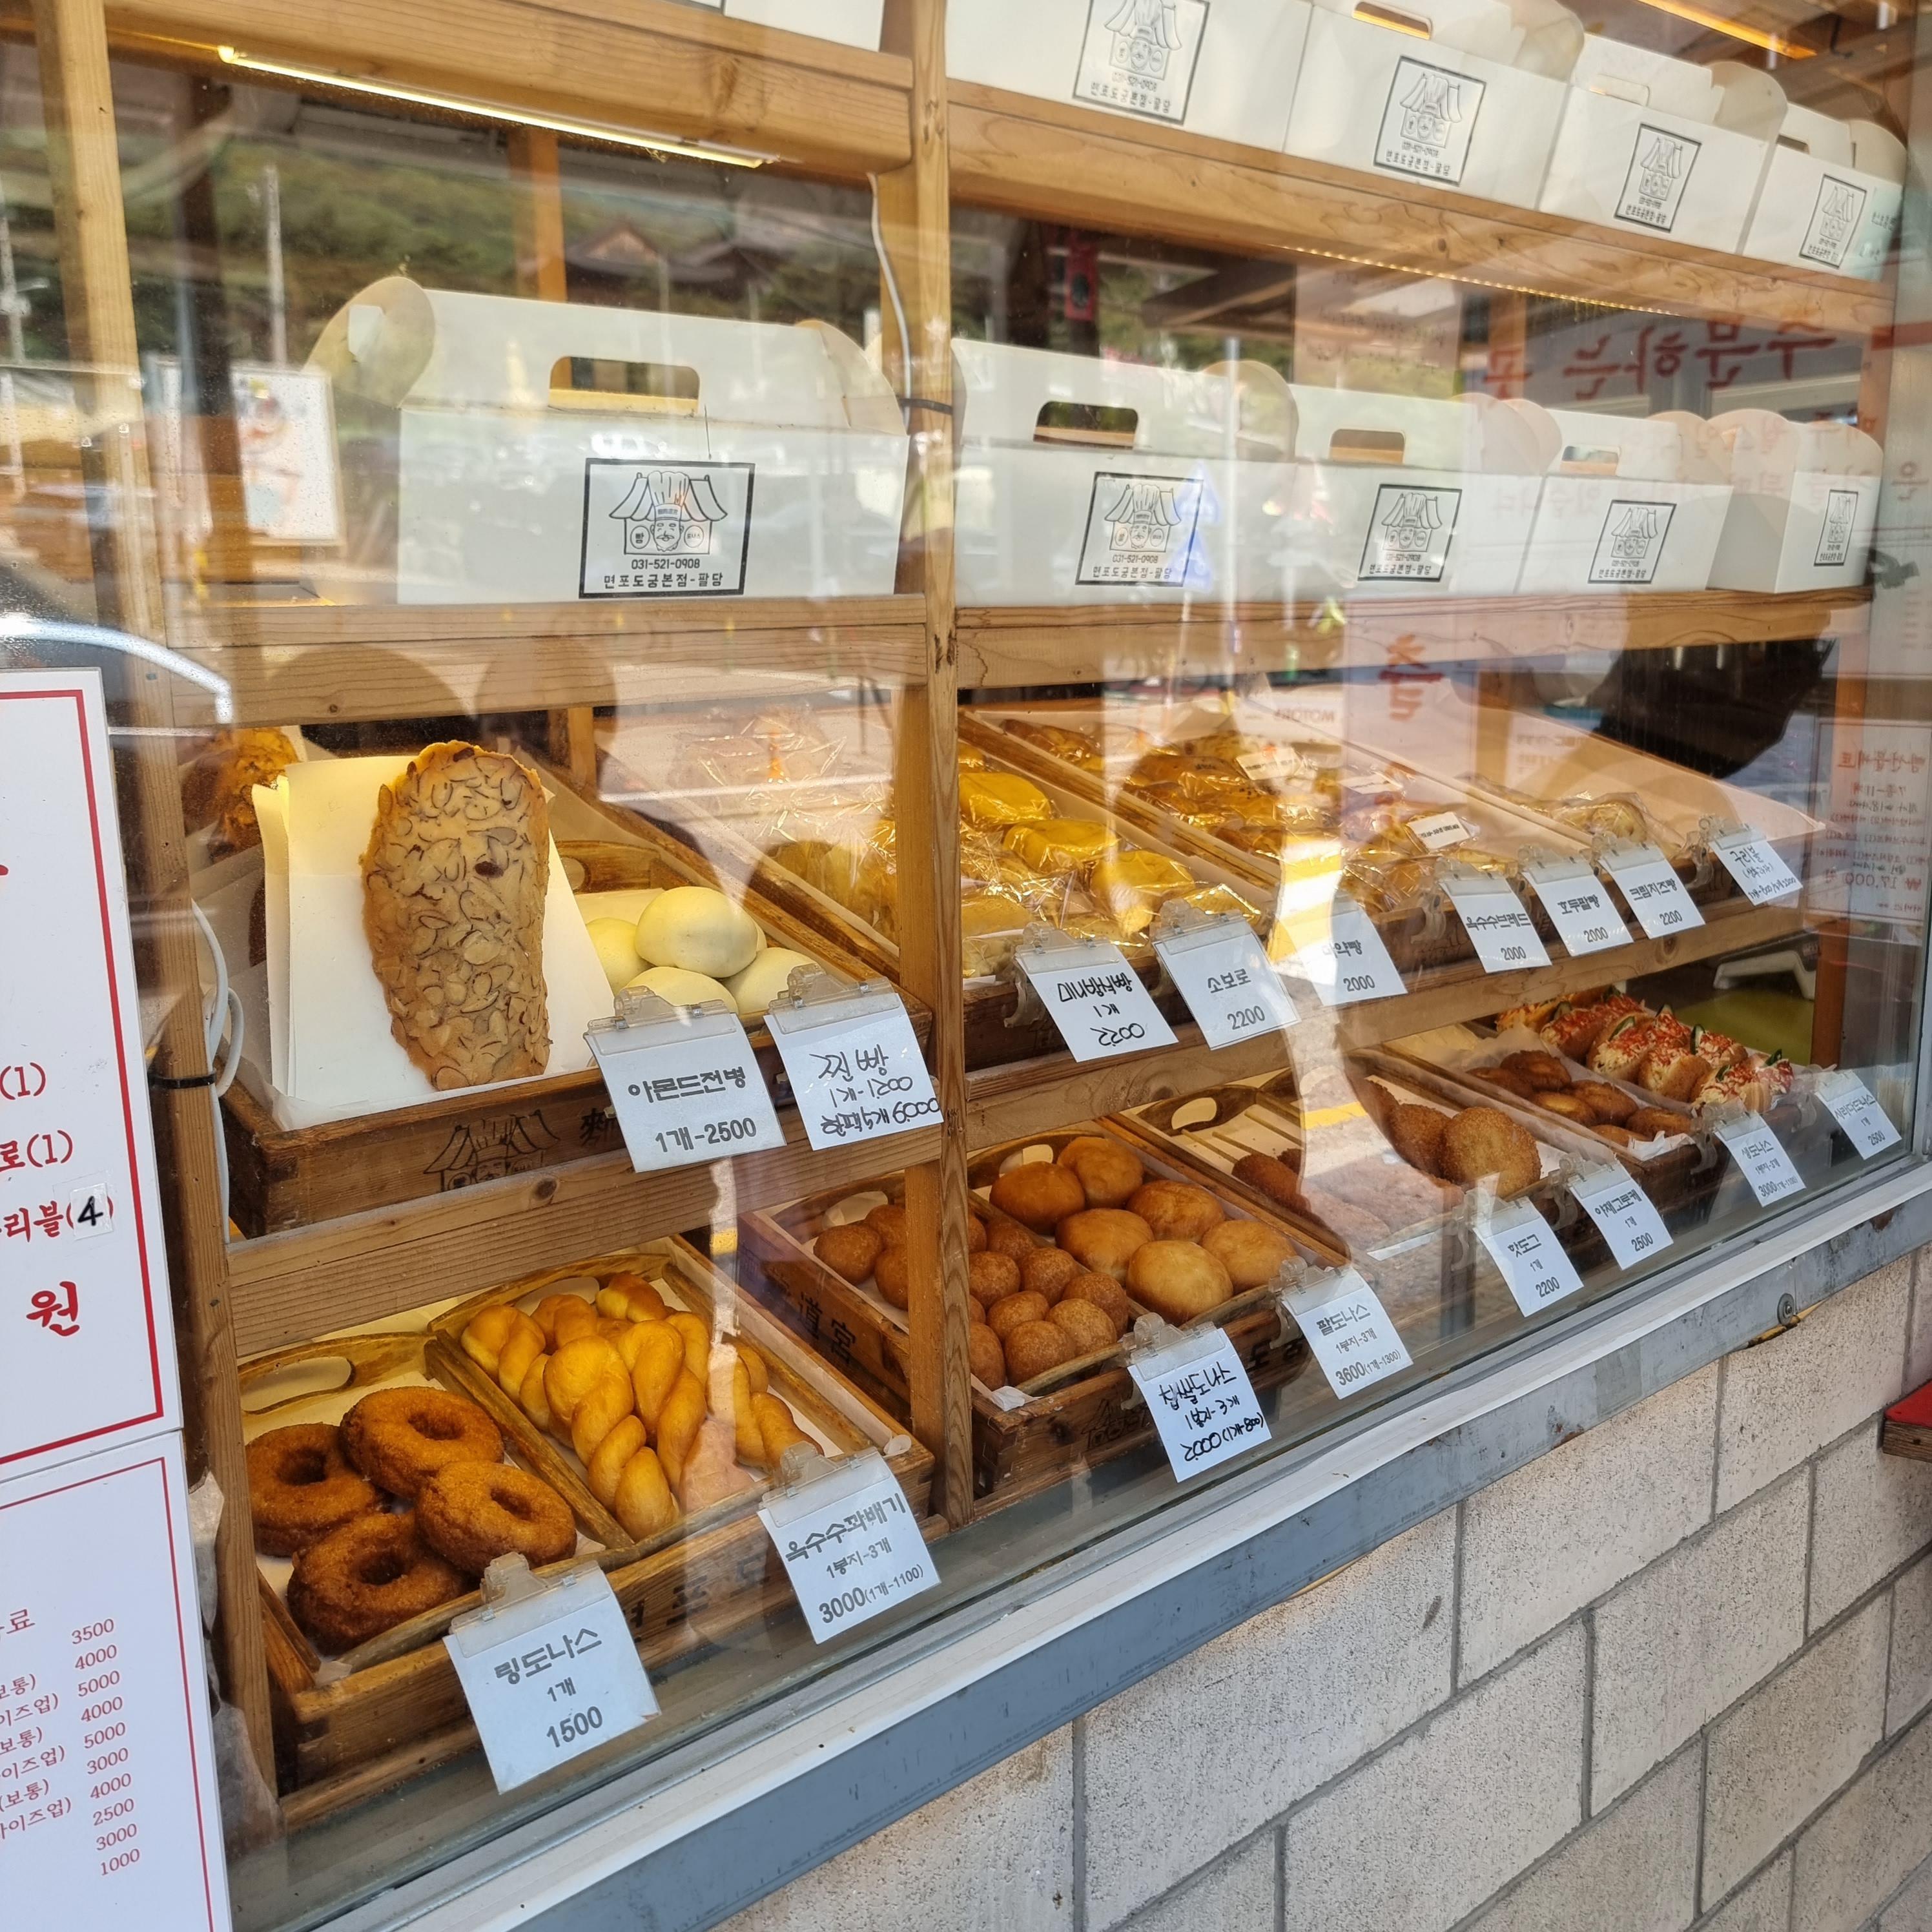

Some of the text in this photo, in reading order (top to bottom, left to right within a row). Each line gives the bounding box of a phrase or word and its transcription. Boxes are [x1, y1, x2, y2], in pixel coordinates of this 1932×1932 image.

[631, 558, 701, 570] 031-521-0908
[1629, 878, 1678, 901] 크림치즈빵
[1466, 912, 1532, 931] 옥수수브레드
[1660, 910, 1683, 926] 2200
[1583, 927, 1608, 943] 2000
[1501, 946, 1526, 961] 2000
[1207, 968, 1252, 994] 소보로
[1343, 974, 1375, 992] 2000
[1093, 1003, 1120, 1018] 1개
[1227, 1005, 1266, 1031] 2200
[628, 1065, 746, 1104] 아몬드전병
[655, 1117, 757, 1153] 1개-2500
[0, 1196, 114, 1242] 리블(4)
[1624, 1215, 1638, 1229] 1개
[1507, 1233, 1543, 1259] 핫도그
[1630, 1232, 1654, 1253] 2500
[1530, 1259, 1544, 1273] 1개
[1535, 1276, 1561, 1299] 2200
[26, 1280, 80, 1337] 원
[1335, 1327, 1378, 1355] 1봉지-3개
[785, 1492, 907, 1563] 옥수수꽈배기
[826, 1537, 892, 1579] 1봉지-3개
[71, 1618, 114, 1645] 3500
[75, 1644, 118, 1670] 4000
[494, 1627, 602, 1685] 링도나스
[77, 1670, 120, 1697] 5000
[547, 1676, 577, 1702] 1개
[81, 1696, 123, 1722] 4000
[84, 1722, 126, 1749] 5000
[546, 1706, 603, 1748] 1500
[87, 1747, 128, 1774] 3000
[90, 1773, 132, 1799] 4000
[92, 1798, 134, 1826] 2500
[96, 1823, 138, 1851] 3000
[100, 1848, 140, 1876] 1000
